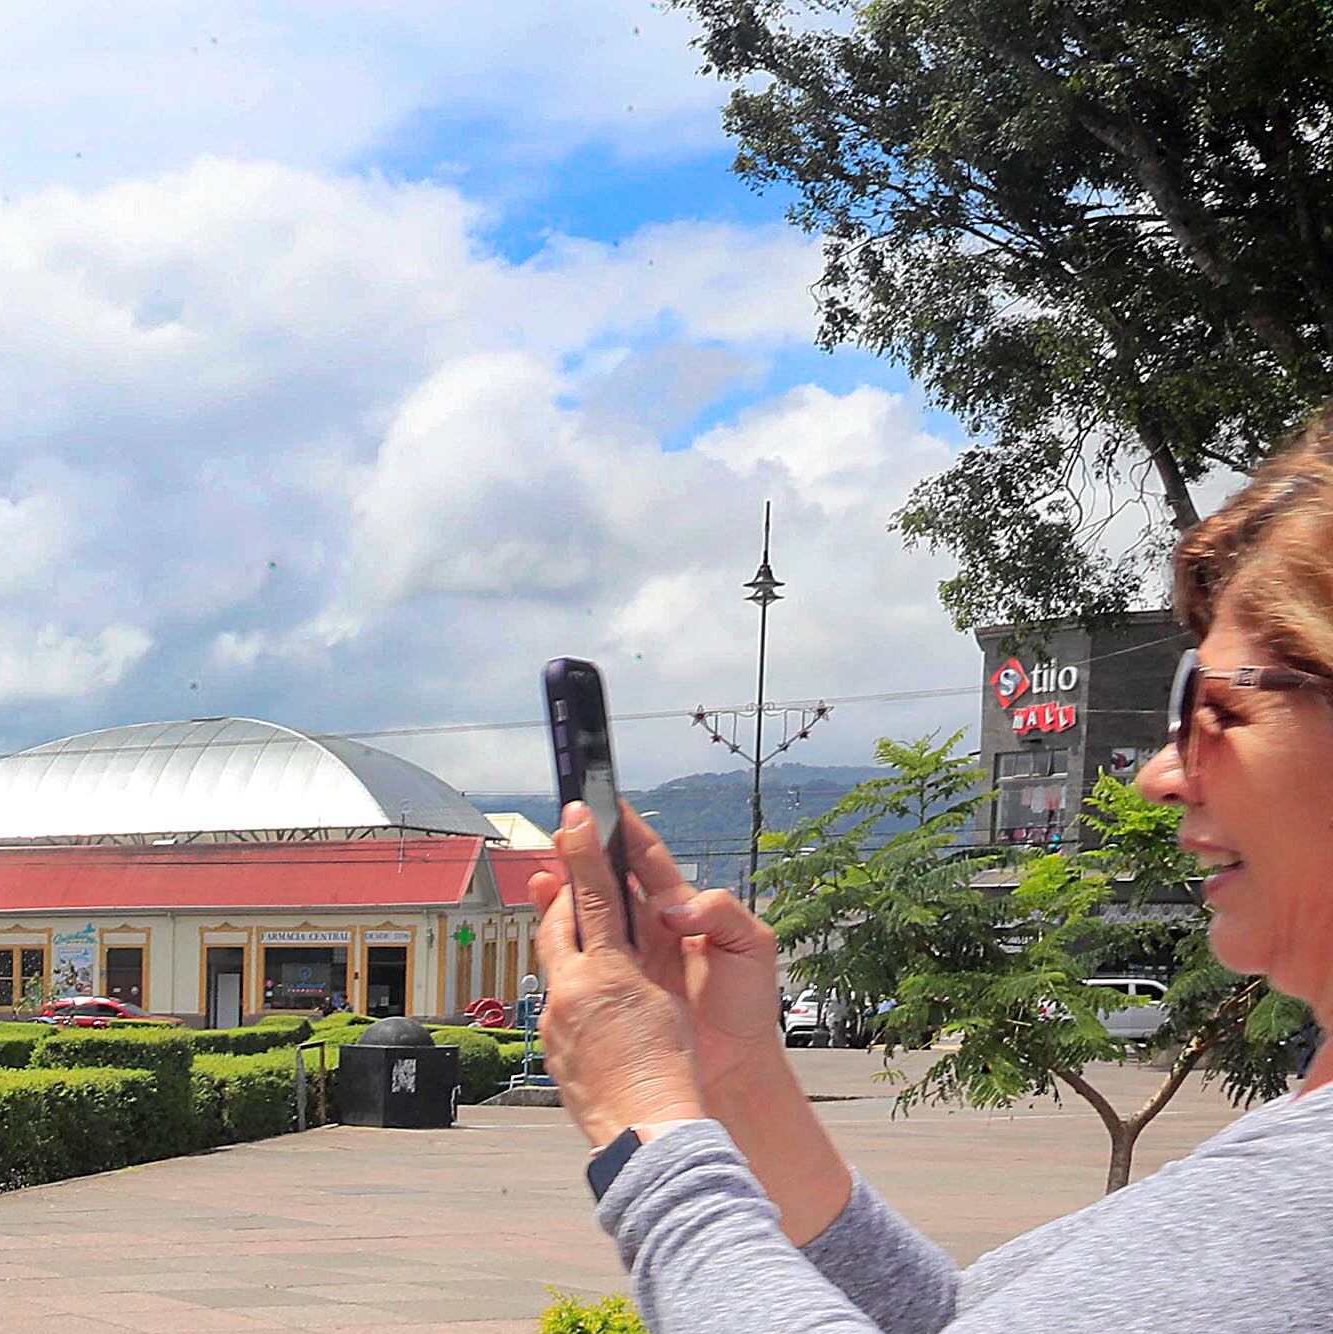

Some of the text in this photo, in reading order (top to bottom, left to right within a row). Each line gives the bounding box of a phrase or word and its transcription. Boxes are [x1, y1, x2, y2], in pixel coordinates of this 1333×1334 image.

[1013, 706, 1069, 729] MALL
[261, 932, 349, 941] FARMACIA CENTRAL
